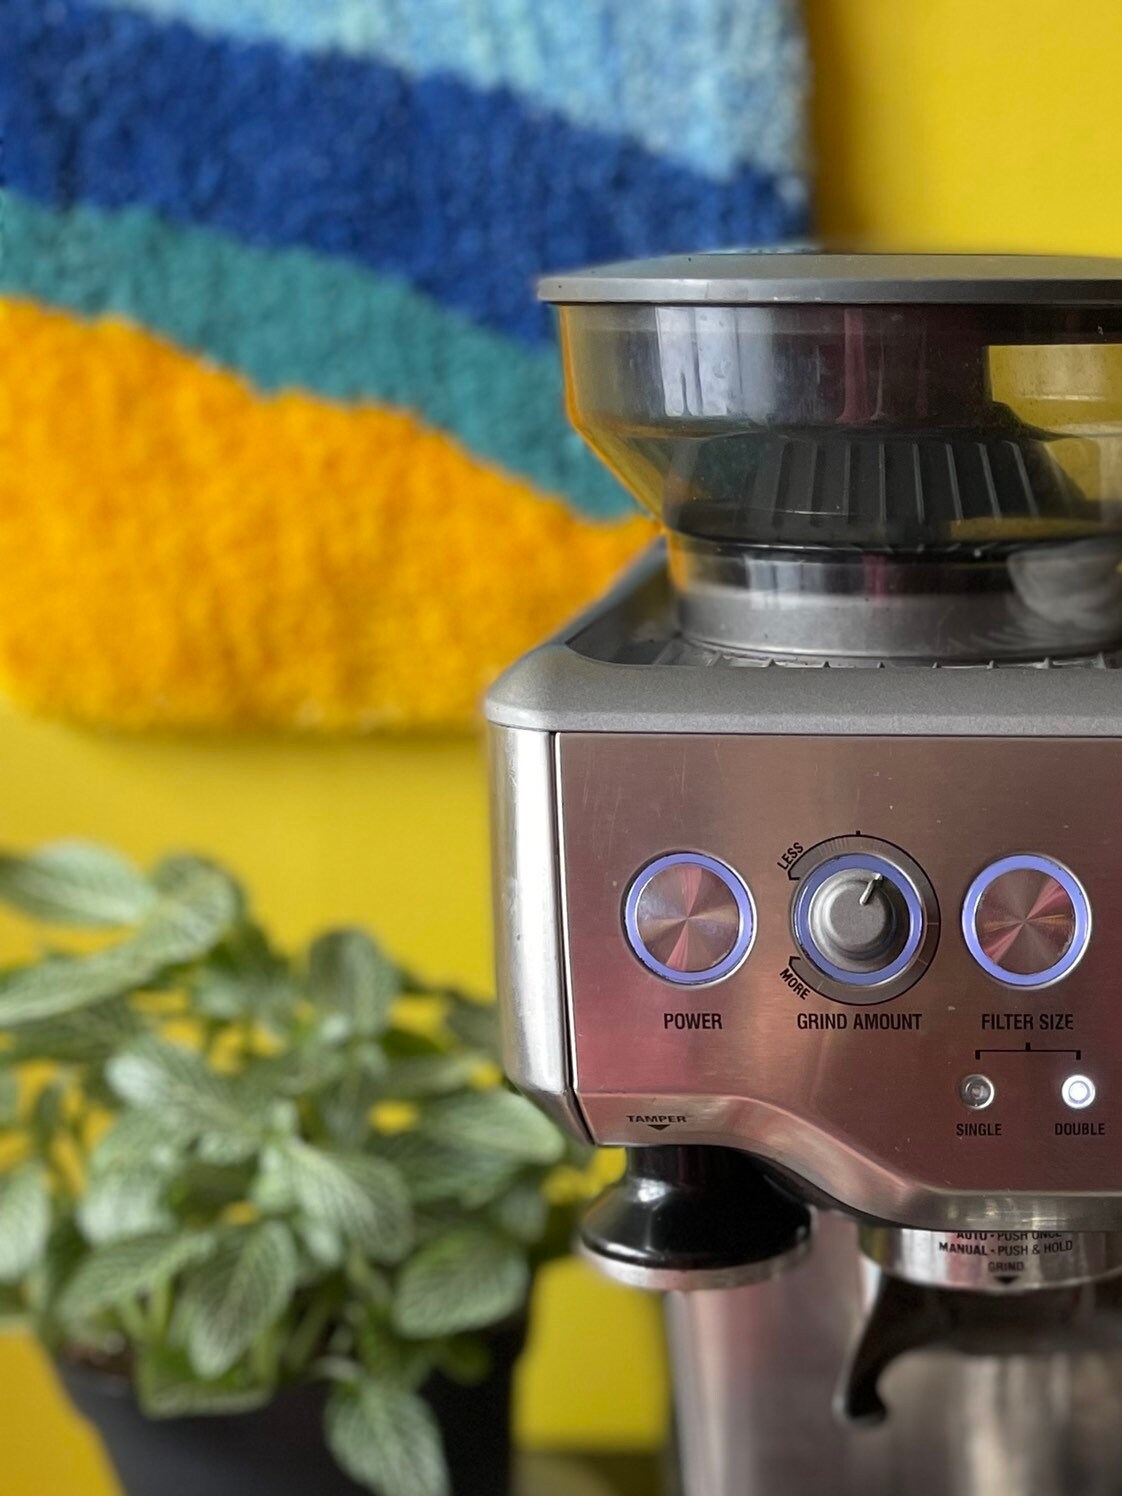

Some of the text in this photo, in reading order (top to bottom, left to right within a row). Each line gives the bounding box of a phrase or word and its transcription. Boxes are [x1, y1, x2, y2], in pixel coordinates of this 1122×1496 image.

[777, 842, 804, 870] LESS
[779, 968, 811, 1000] MORE
[664, 1013, 723, 1030] POWER
[797, 1013, 922, 1030] GRIND AMOUNT
[981, 1013, 1074, 1030] FILTER SIZE
[626, 1115, 687, 1123] TAMPER
[956, 1123, 1002, 1136] SINGLE
[1055, 1123, 1106, 1136] DOUBLE
[957, 1231, 987, 1240] AUTO
[997, 1231, 1028, 1241] PUSH
[938, 1241, 988, 1257] MANUAL
[997, 1245, 1028, 1256] PUSH
[1031, 1244, 1041, 1255] &
[1044, 1240, 1073, 1254] HOLD
[987, 1261, 1025, 1273] GRIND
